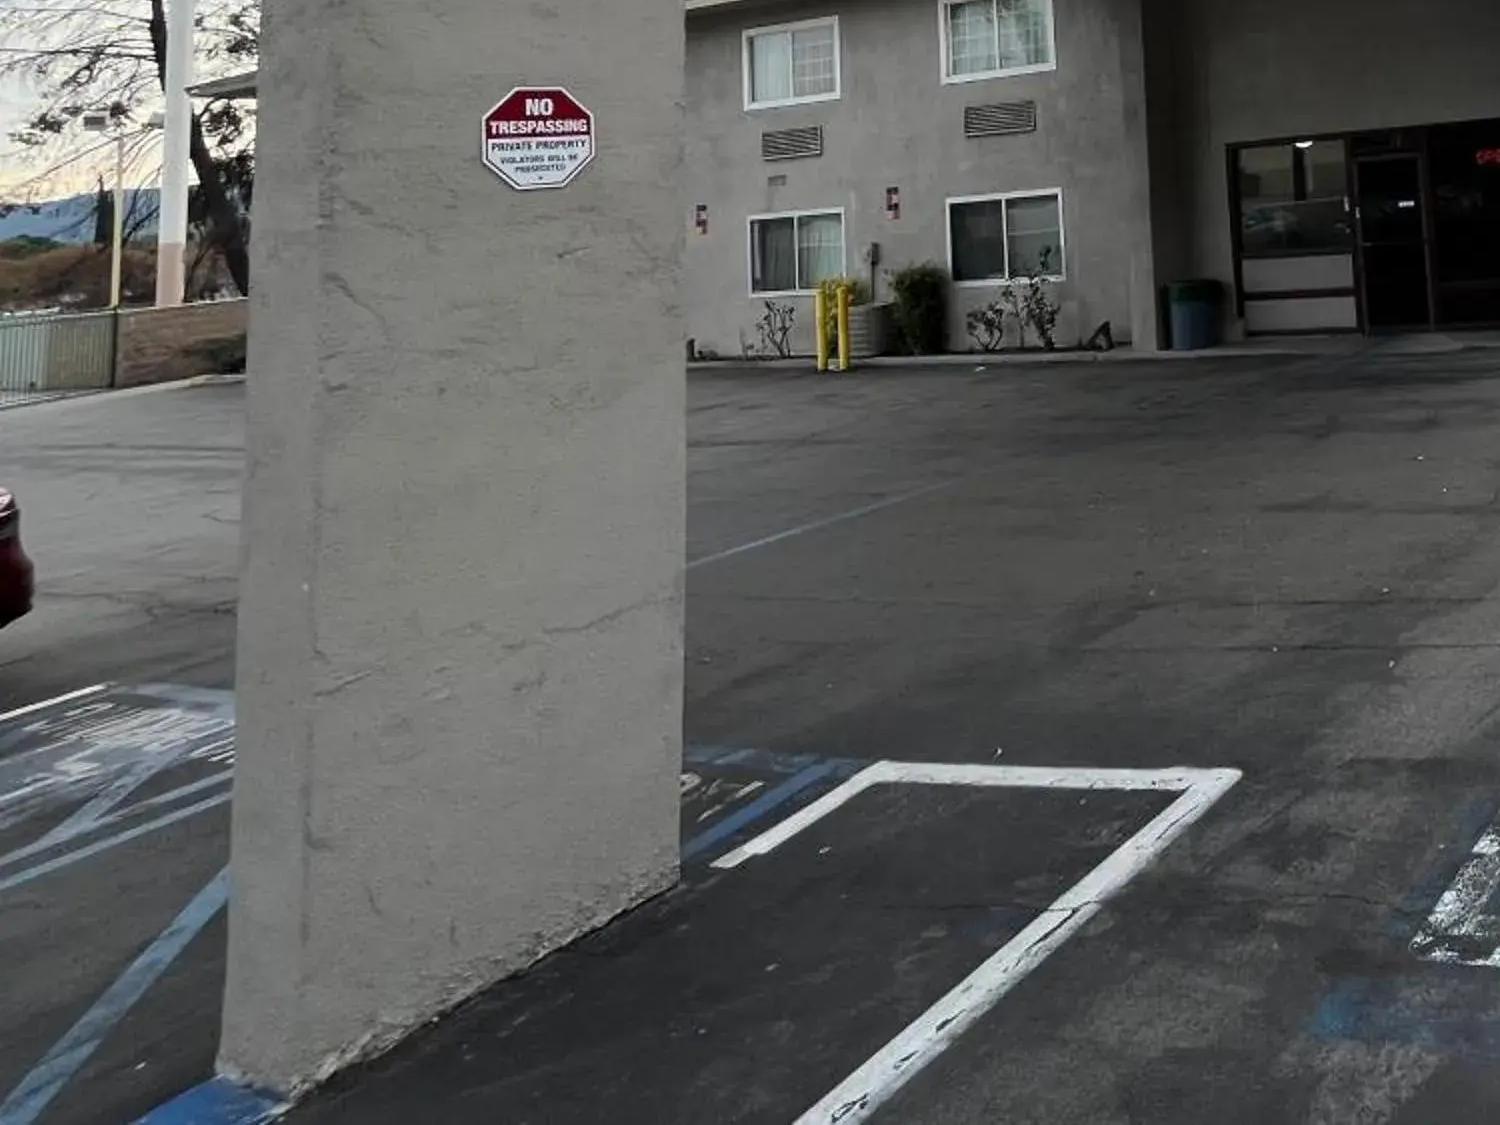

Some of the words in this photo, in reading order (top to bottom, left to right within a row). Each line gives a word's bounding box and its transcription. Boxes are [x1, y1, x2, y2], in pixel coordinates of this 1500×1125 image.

[525, 98, 554, 116] NO
[489, 119, 588, 135] TRESPASSING
[491, 142, 532, 151] PRIVATE
[535, 139, 586, 150] PROPERTY
